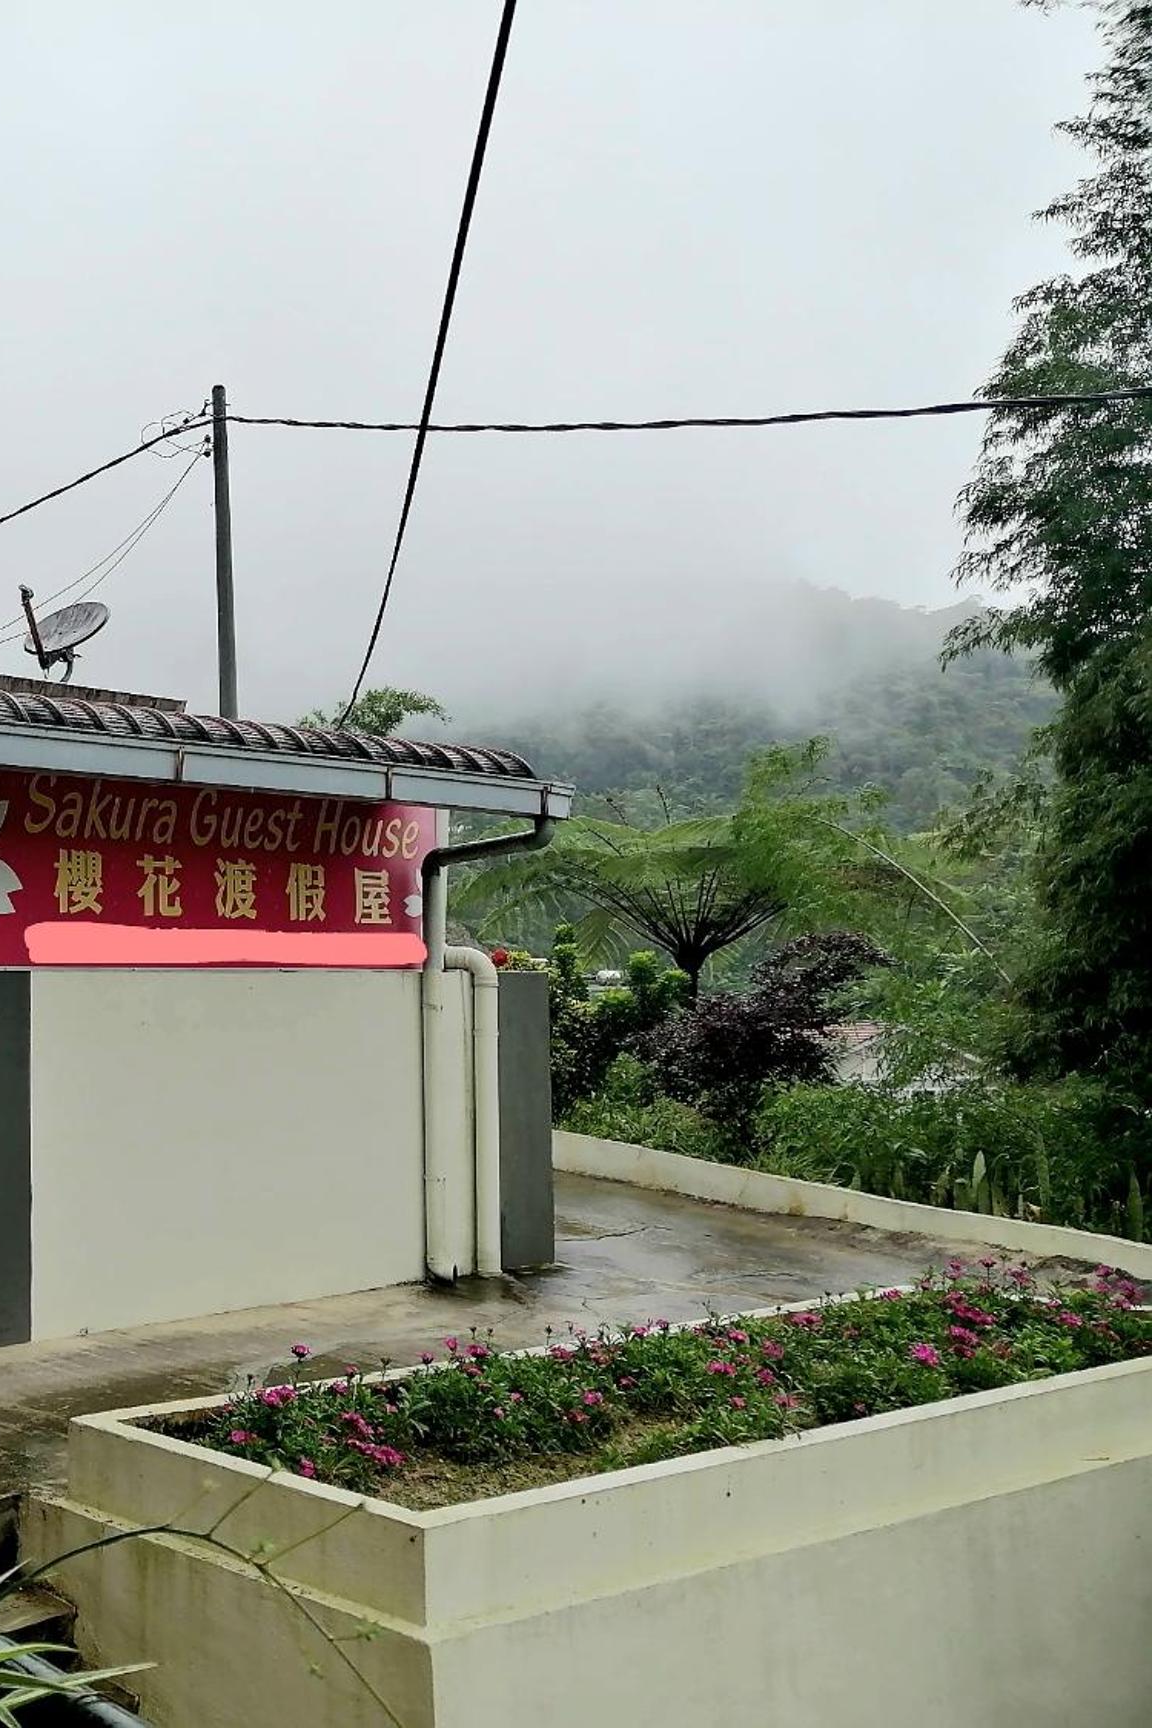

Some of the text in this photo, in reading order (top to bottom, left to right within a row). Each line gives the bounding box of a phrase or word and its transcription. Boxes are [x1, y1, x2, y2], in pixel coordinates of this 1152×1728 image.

[23, 774, 421, 860] Sakura Guest House
[53, 848, 393, 925] 櫻花渡假屋
